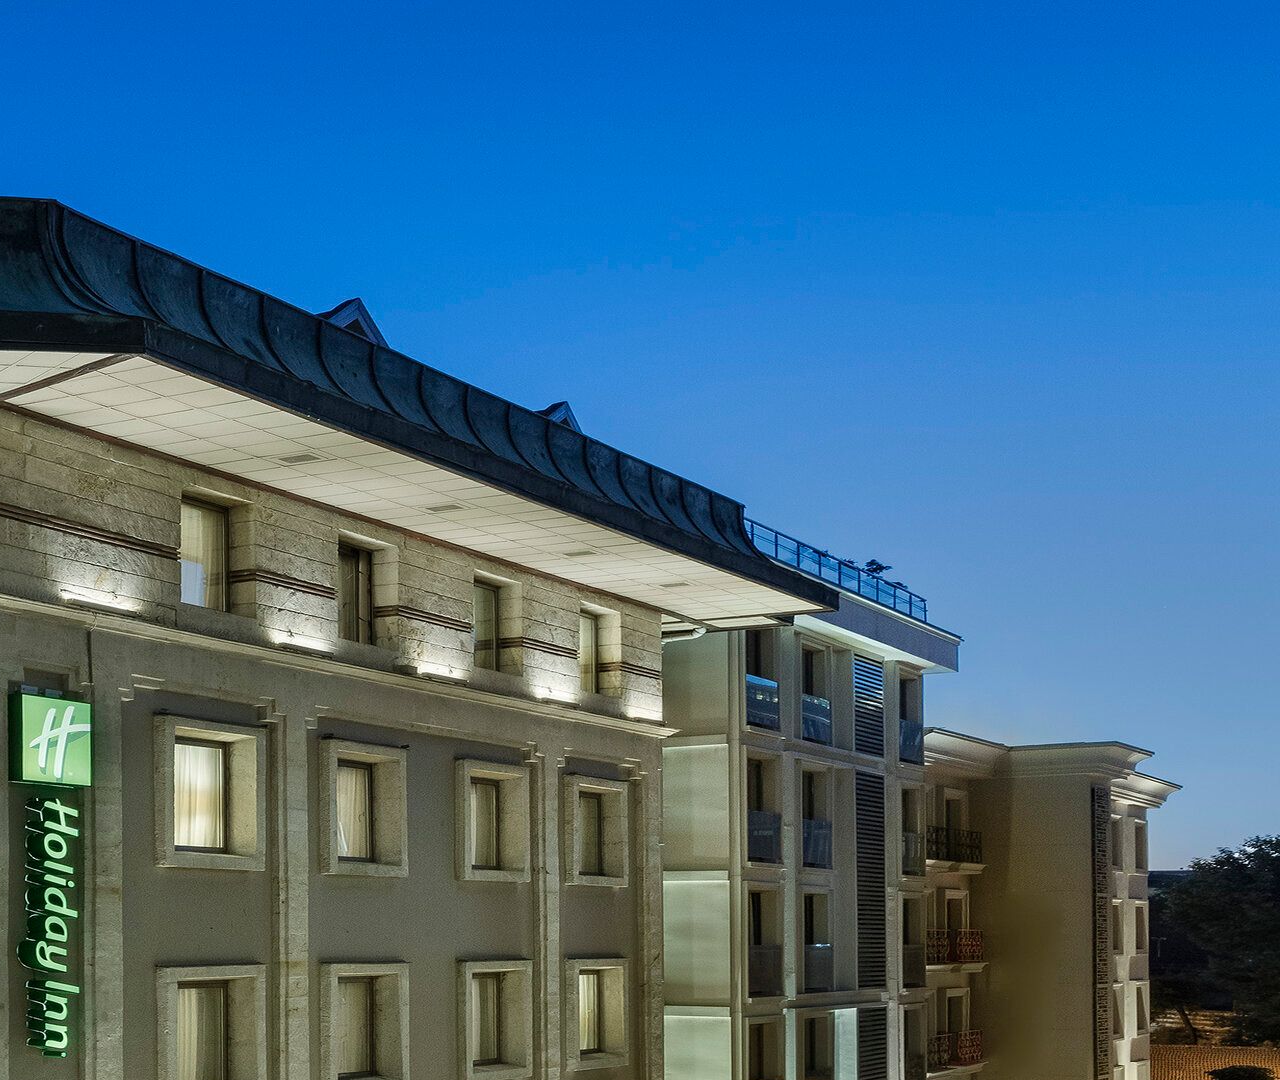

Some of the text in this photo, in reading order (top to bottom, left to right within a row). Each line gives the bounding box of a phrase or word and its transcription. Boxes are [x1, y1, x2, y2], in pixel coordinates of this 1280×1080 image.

[29, 705, 91, 778] H
[35, 798, 80, 1049] Holiday Inn
